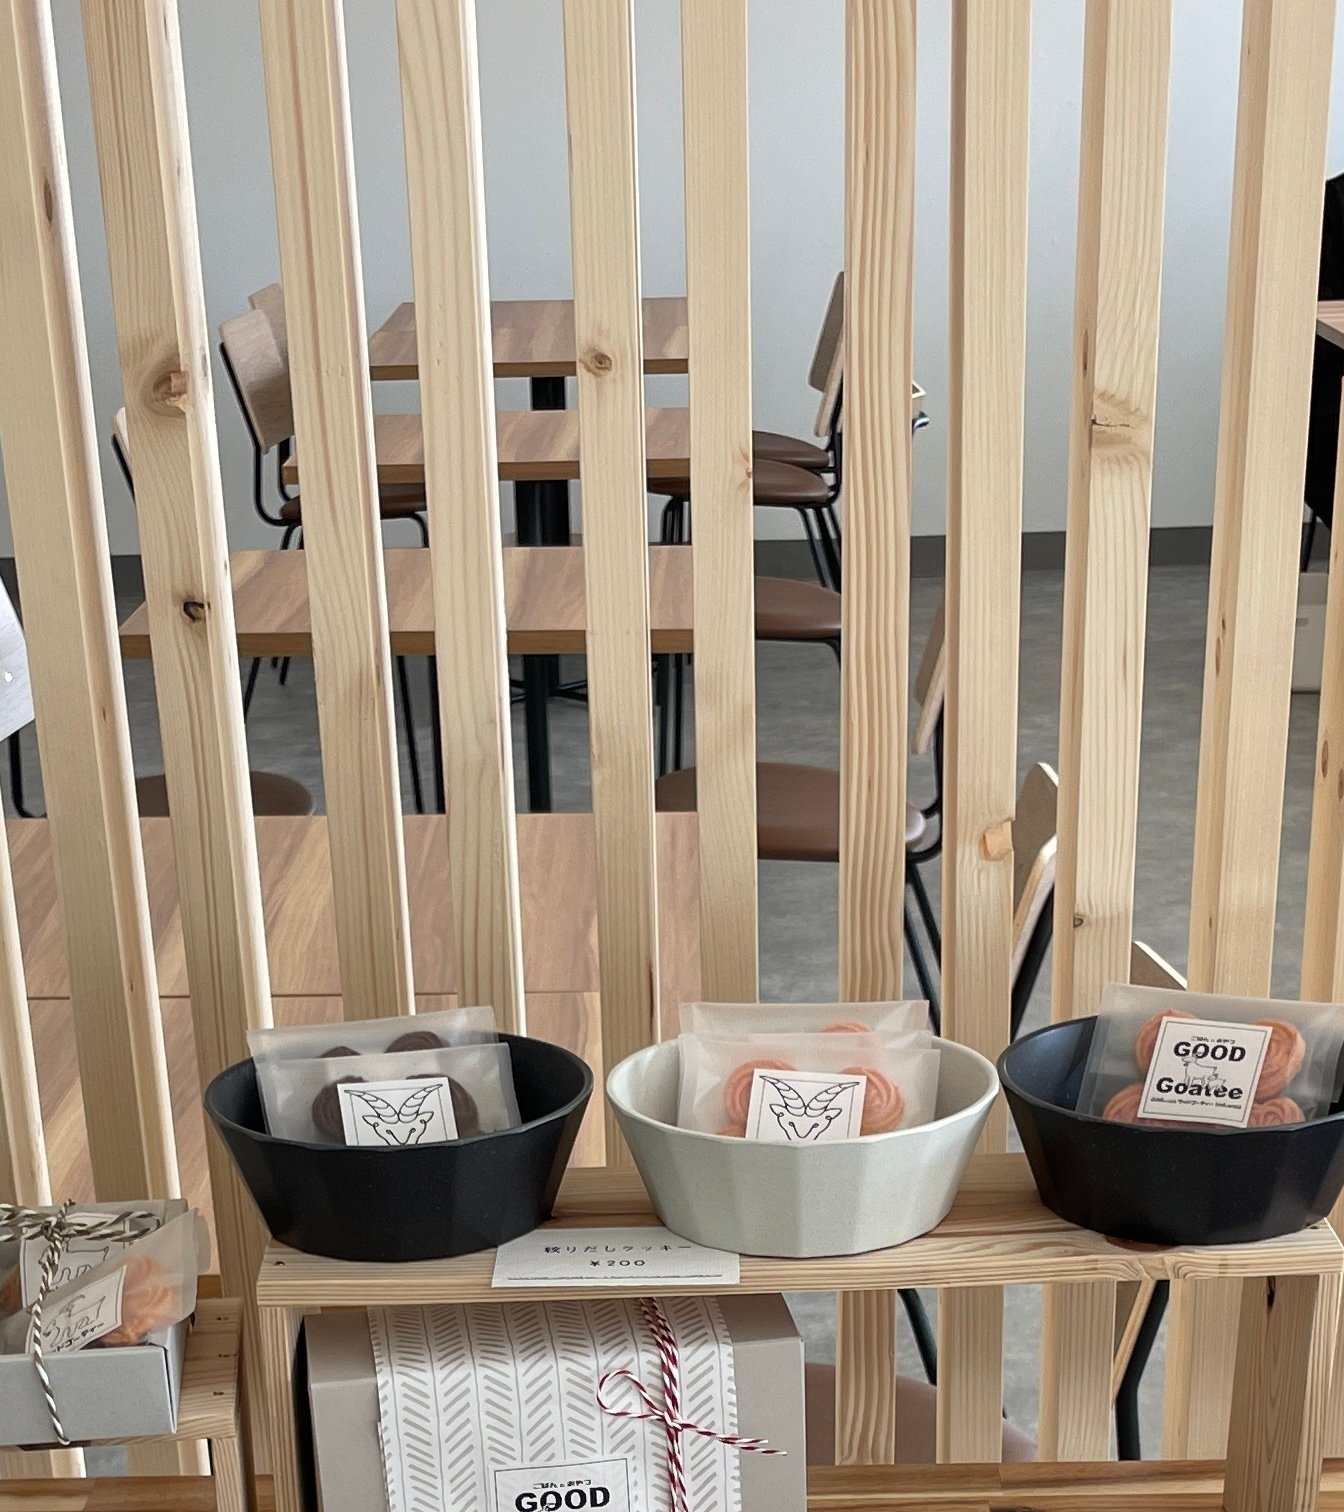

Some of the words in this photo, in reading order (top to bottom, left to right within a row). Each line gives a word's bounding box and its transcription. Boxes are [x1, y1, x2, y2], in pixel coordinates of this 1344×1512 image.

[1173, 1041, 1246, 1062] GOOD
[1156, 1077, 1244, 1100] Goatee
[590, 1259, 646, 1267] ¥200
